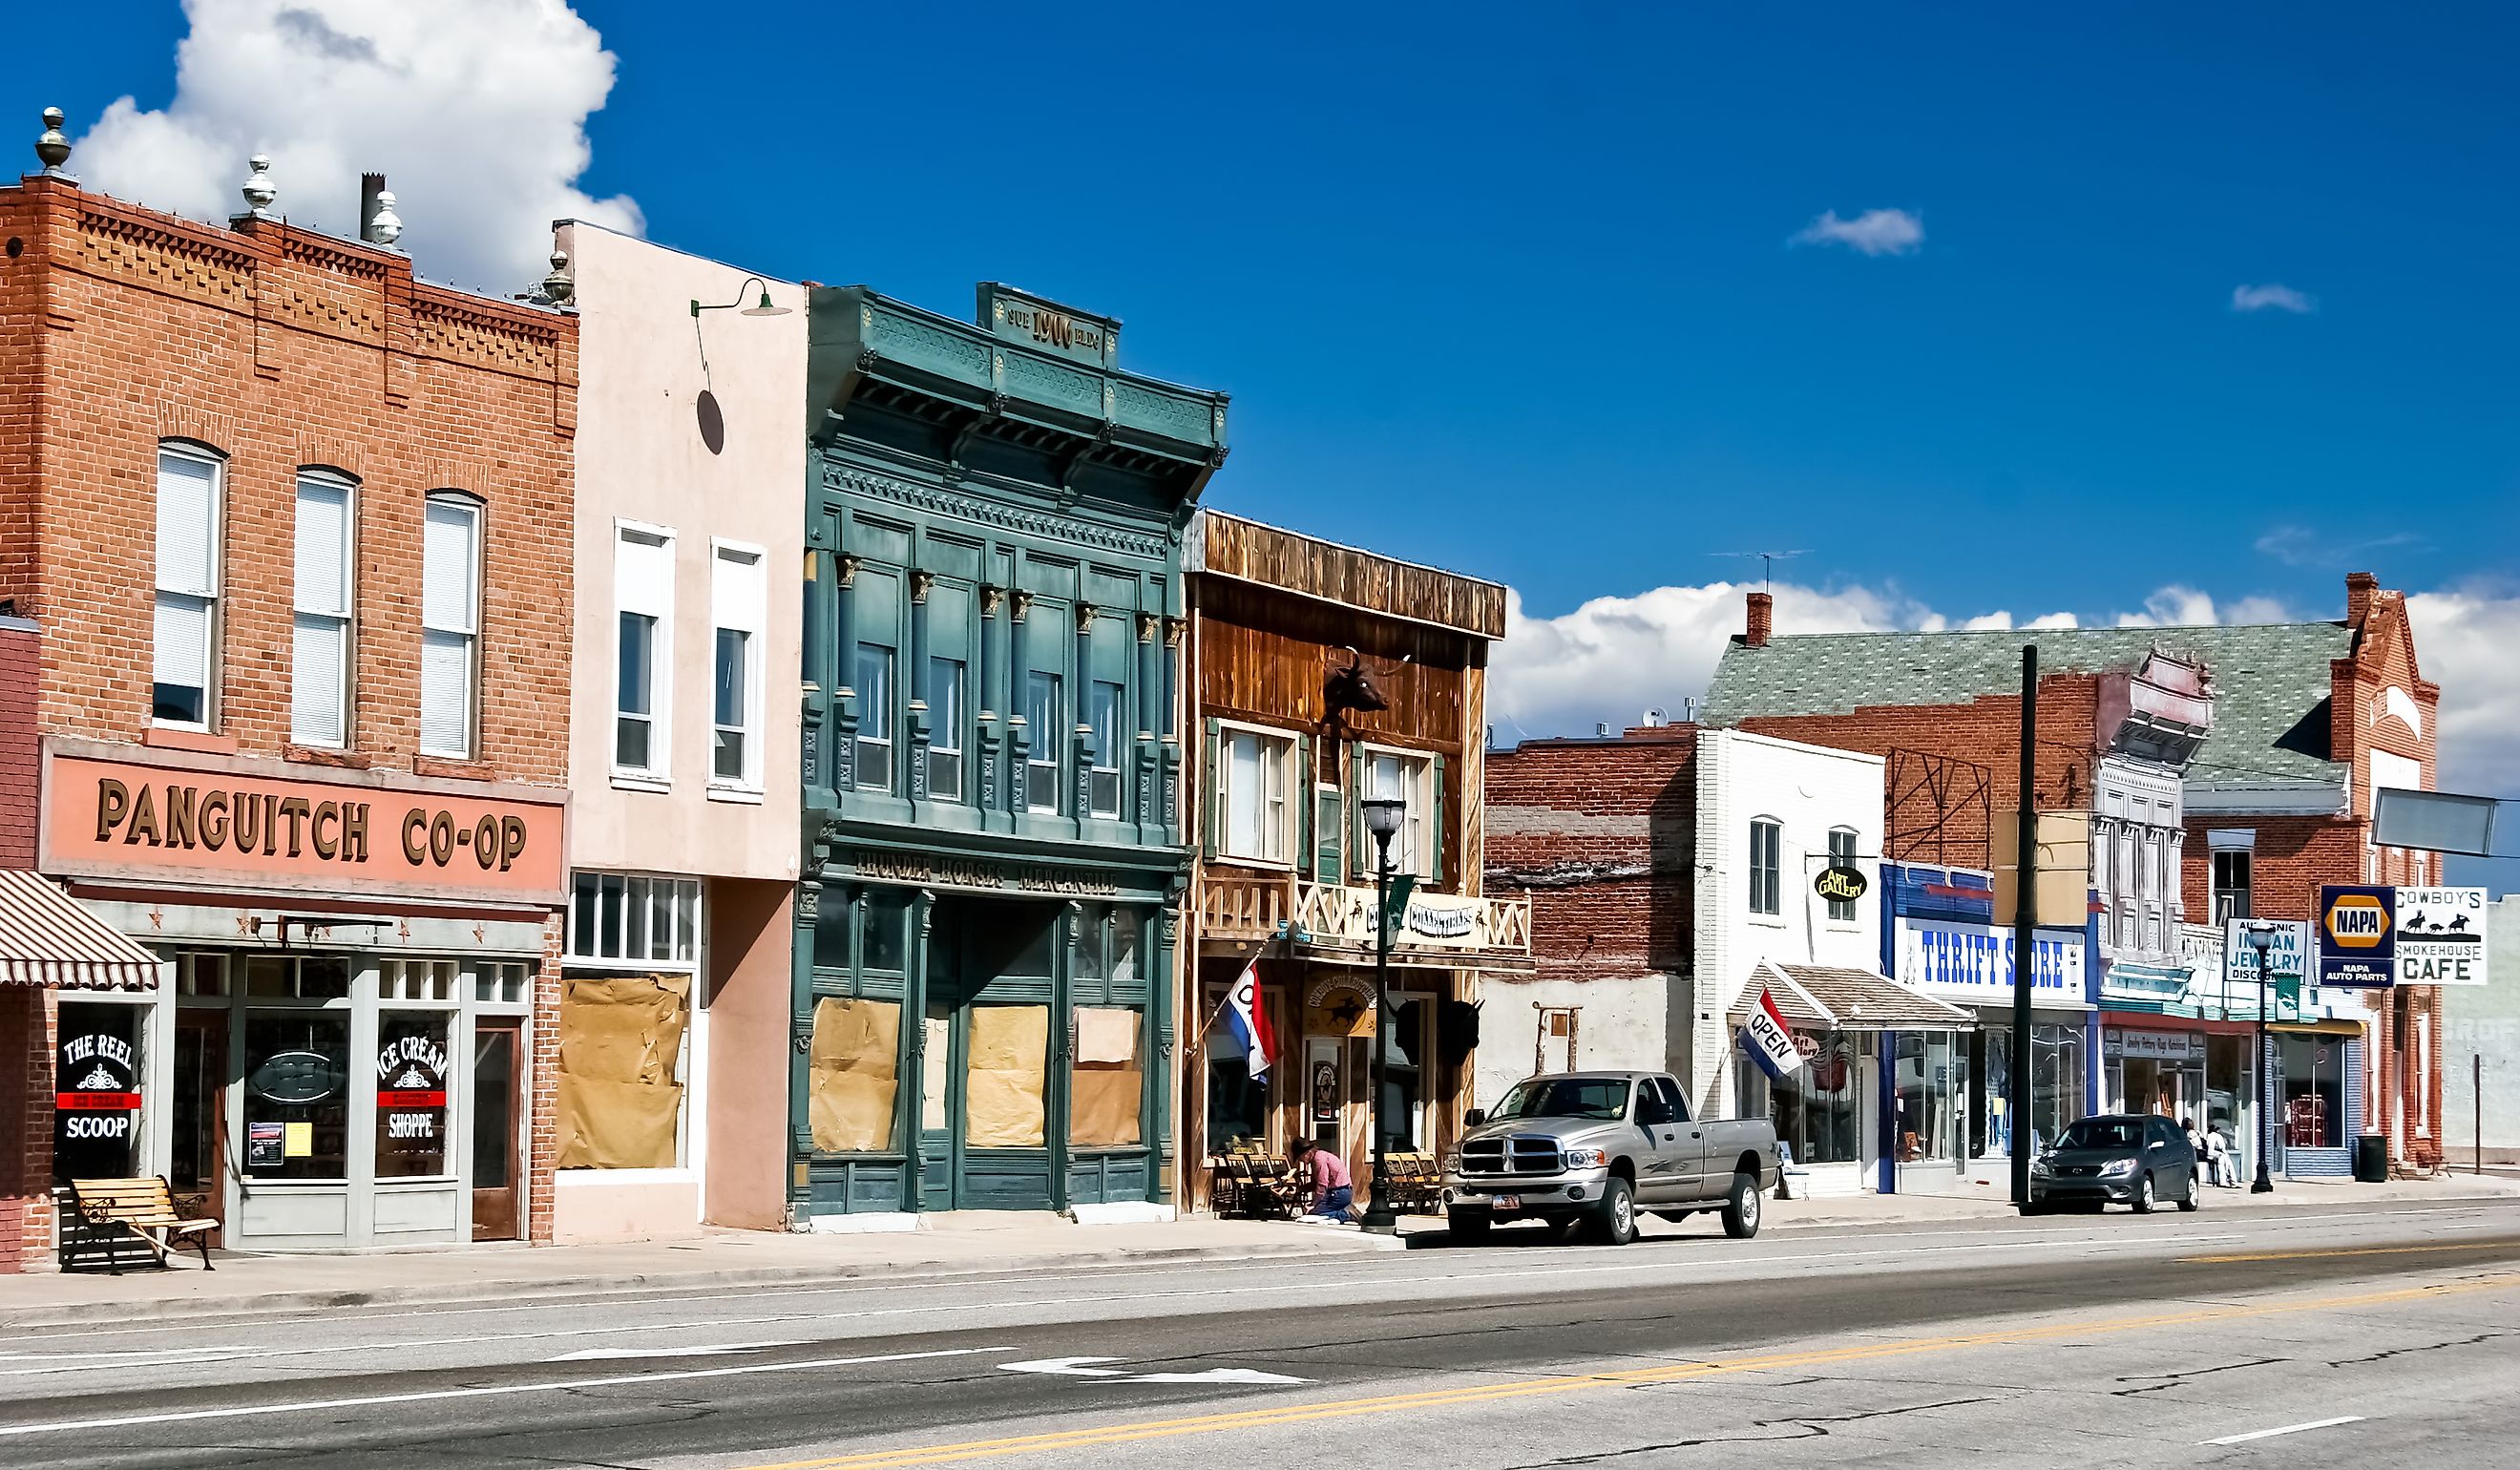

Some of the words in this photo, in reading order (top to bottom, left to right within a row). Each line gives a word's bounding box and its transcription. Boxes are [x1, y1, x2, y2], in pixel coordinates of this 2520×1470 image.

[94, 778, 370, 863] PANGUITCH
[401, 808, 527, 872] CO-OP
[1817, 879, 1862, 898] GALLERY
[1410, 902, 1473, 939] COLLECTIBLES
[2336, 910, 2379, 934] NAPA
[2238, 933, 2295, 952] INAN
[1922, 931, 1999, 985] THRIFT
[2005, 937, 2063, 988] SORE
[2229, 951, 2302, 971] JEWELRY
[2342, 964, 2370, 974] NAPA
[2403, 957, 2471, 980] CAFE
[2355, 973, 2387, 981] PARTS
[1751, 1014, 1793, 1059] OPEN
[63, 1034, 94, 1065] THE
[97, 1034, 132, 1071] REEL
[376, 1041, 401, 1081] ICE
[401, 1036, 449, 1082] CREAM
[66, 1116, 129, 1138] SCOOP
[388, 1113, 433, 1138] SHOPPE
